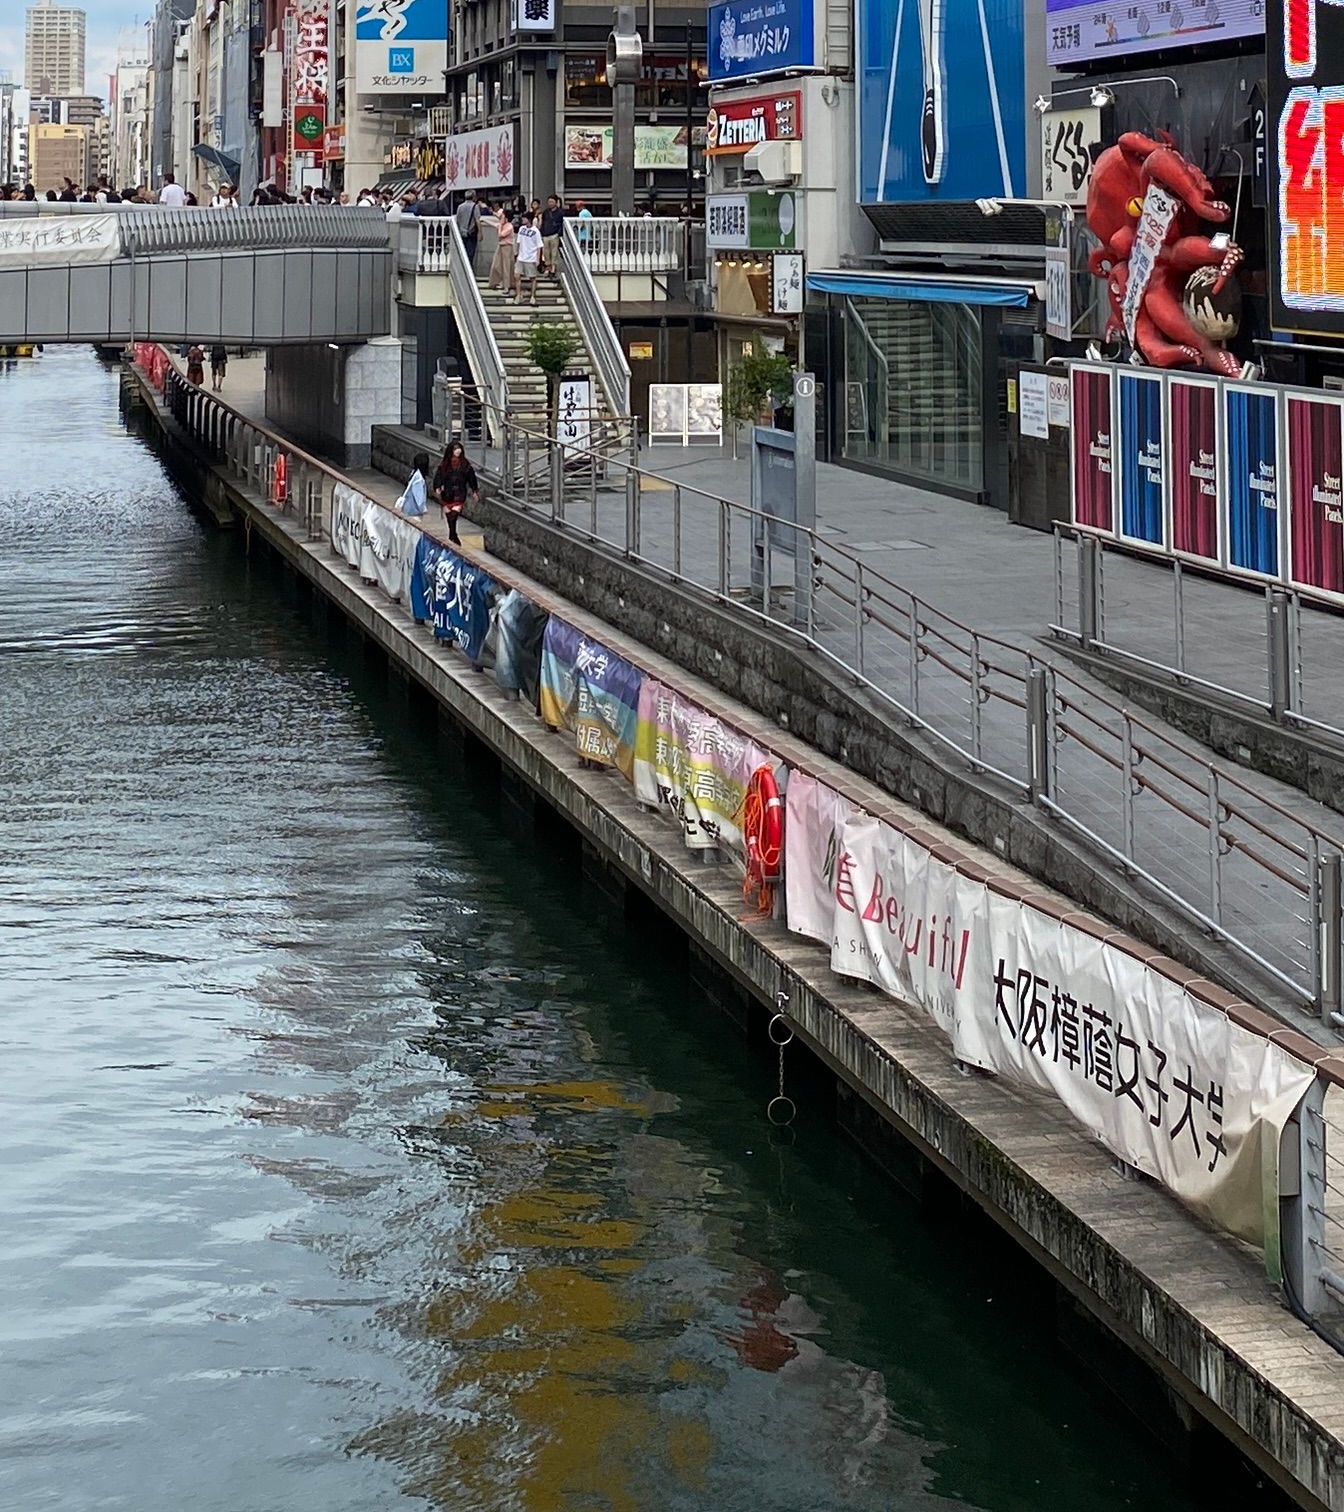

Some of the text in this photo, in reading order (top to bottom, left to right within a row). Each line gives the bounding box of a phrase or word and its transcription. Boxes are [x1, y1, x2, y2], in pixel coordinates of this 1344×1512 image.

[737, 24, 790, 62] 雪印メグミルク
[1052, 23, 1081, 51] 天気予報
[392, 52, 412, 67] BX
[372, 75, 433, 87] 文化シャッター
[718, 114, 766, 147] ZETTERIA
[788, 257, 800, 290] らぁ麺
[777, 277, 788, 311] つけ麺
